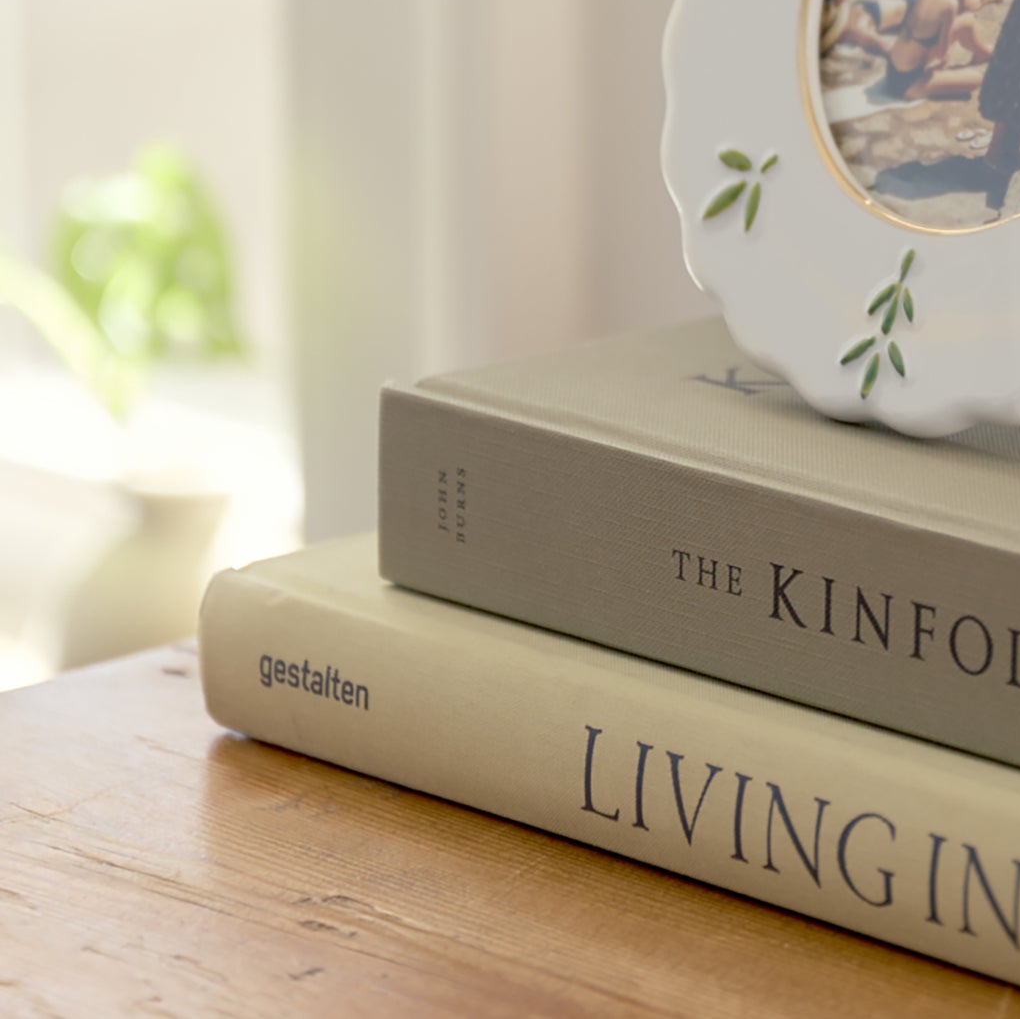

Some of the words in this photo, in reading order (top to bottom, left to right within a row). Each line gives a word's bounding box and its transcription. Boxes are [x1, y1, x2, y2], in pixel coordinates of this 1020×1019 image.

[438, 469, 449, 532] JOHN
[456, 466, 467, 543] BURNS
[672, 548, 743, 597] THE
[259, 654, 369, 711] gestalten
[580, 725, 897, 907] LIVING
